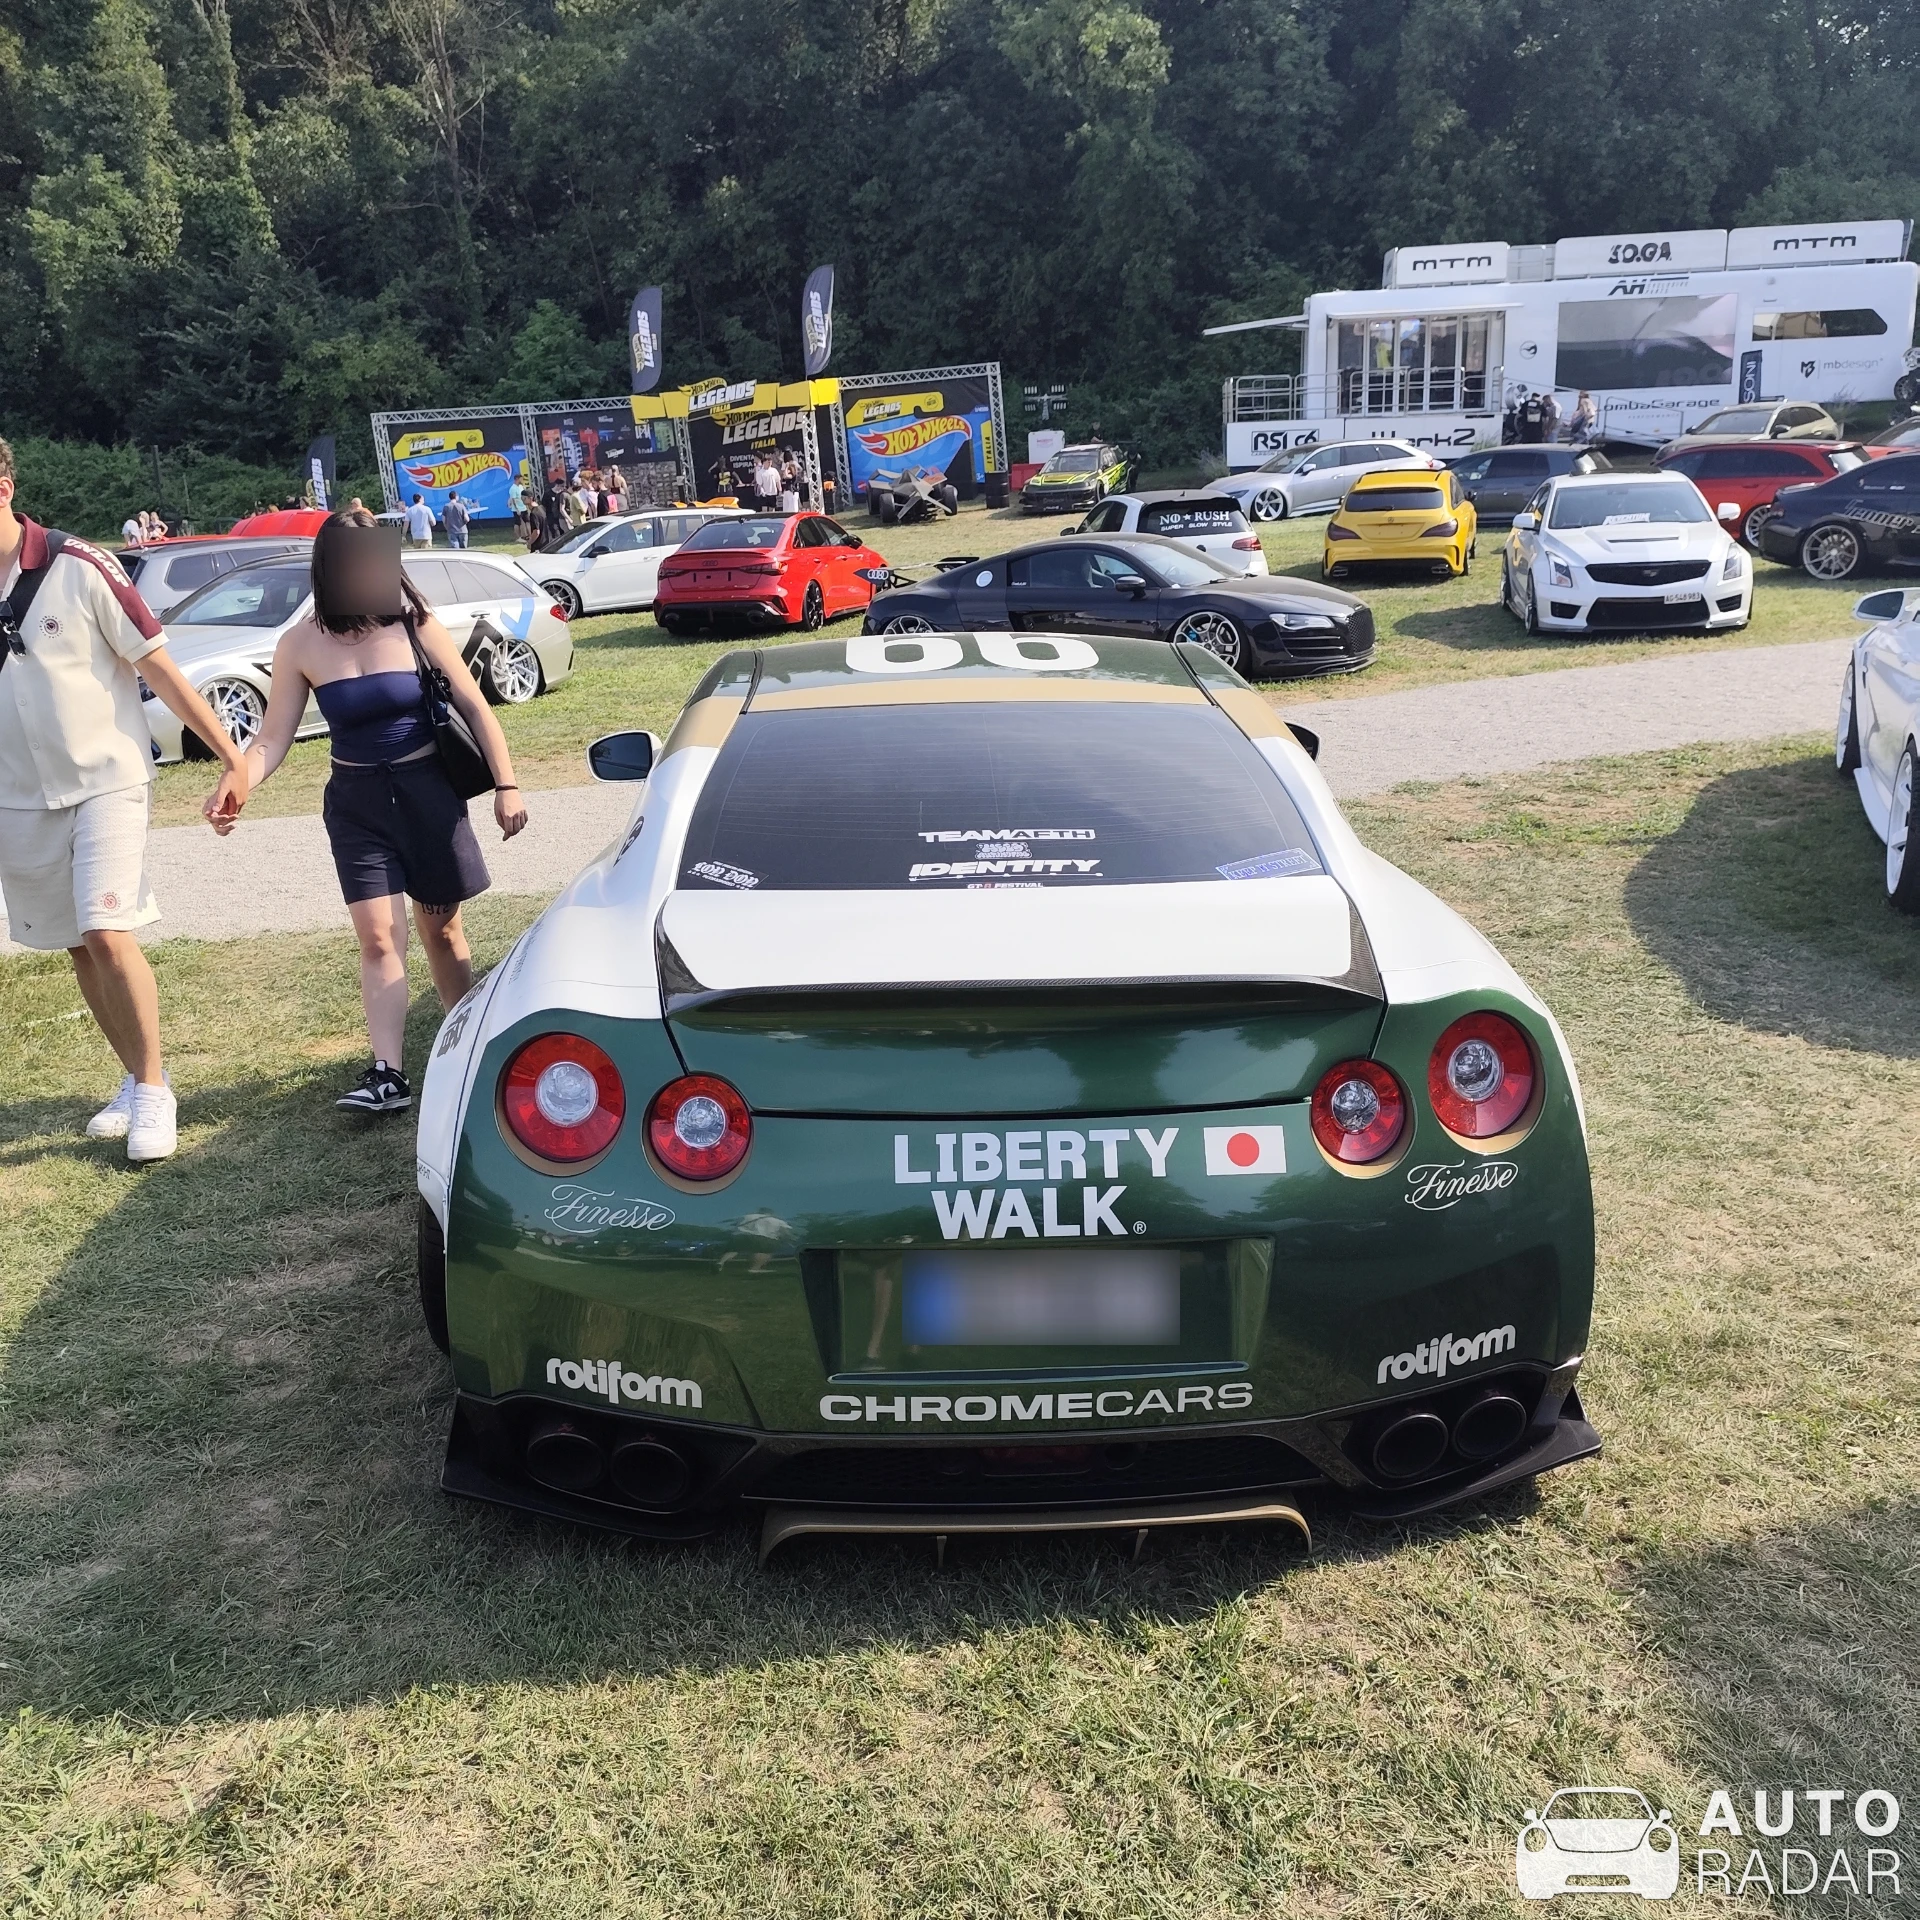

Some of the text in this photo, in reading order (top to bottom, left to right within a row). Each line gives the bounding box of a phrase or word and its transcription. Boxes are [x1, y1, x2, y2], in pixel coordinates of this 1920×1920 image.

[689, 379, 757, 411] LEGENDS
[709, 403, 731, 415] ITALIA
[722, 411, 809, 445] LEGENDS
[750, 437, 777, 450] ITALIA
[1194, 511, 1230, 522] RUSH
[909, 859, 1101, 877] IDENTITY
[894, 1126, 1180, 1184] LIBERTY
[1404, 1159, 1518, 1211] Finesse
[544, 1184, 676, 1233] Finesse
[930, 1185, 1129, 1240] WALK
[1376, 1324, 1516, 1385] rotiform
[546, 1357, 703, 1409] rotiform
[819, 1382, 1253, 1423] CHROMECARS
